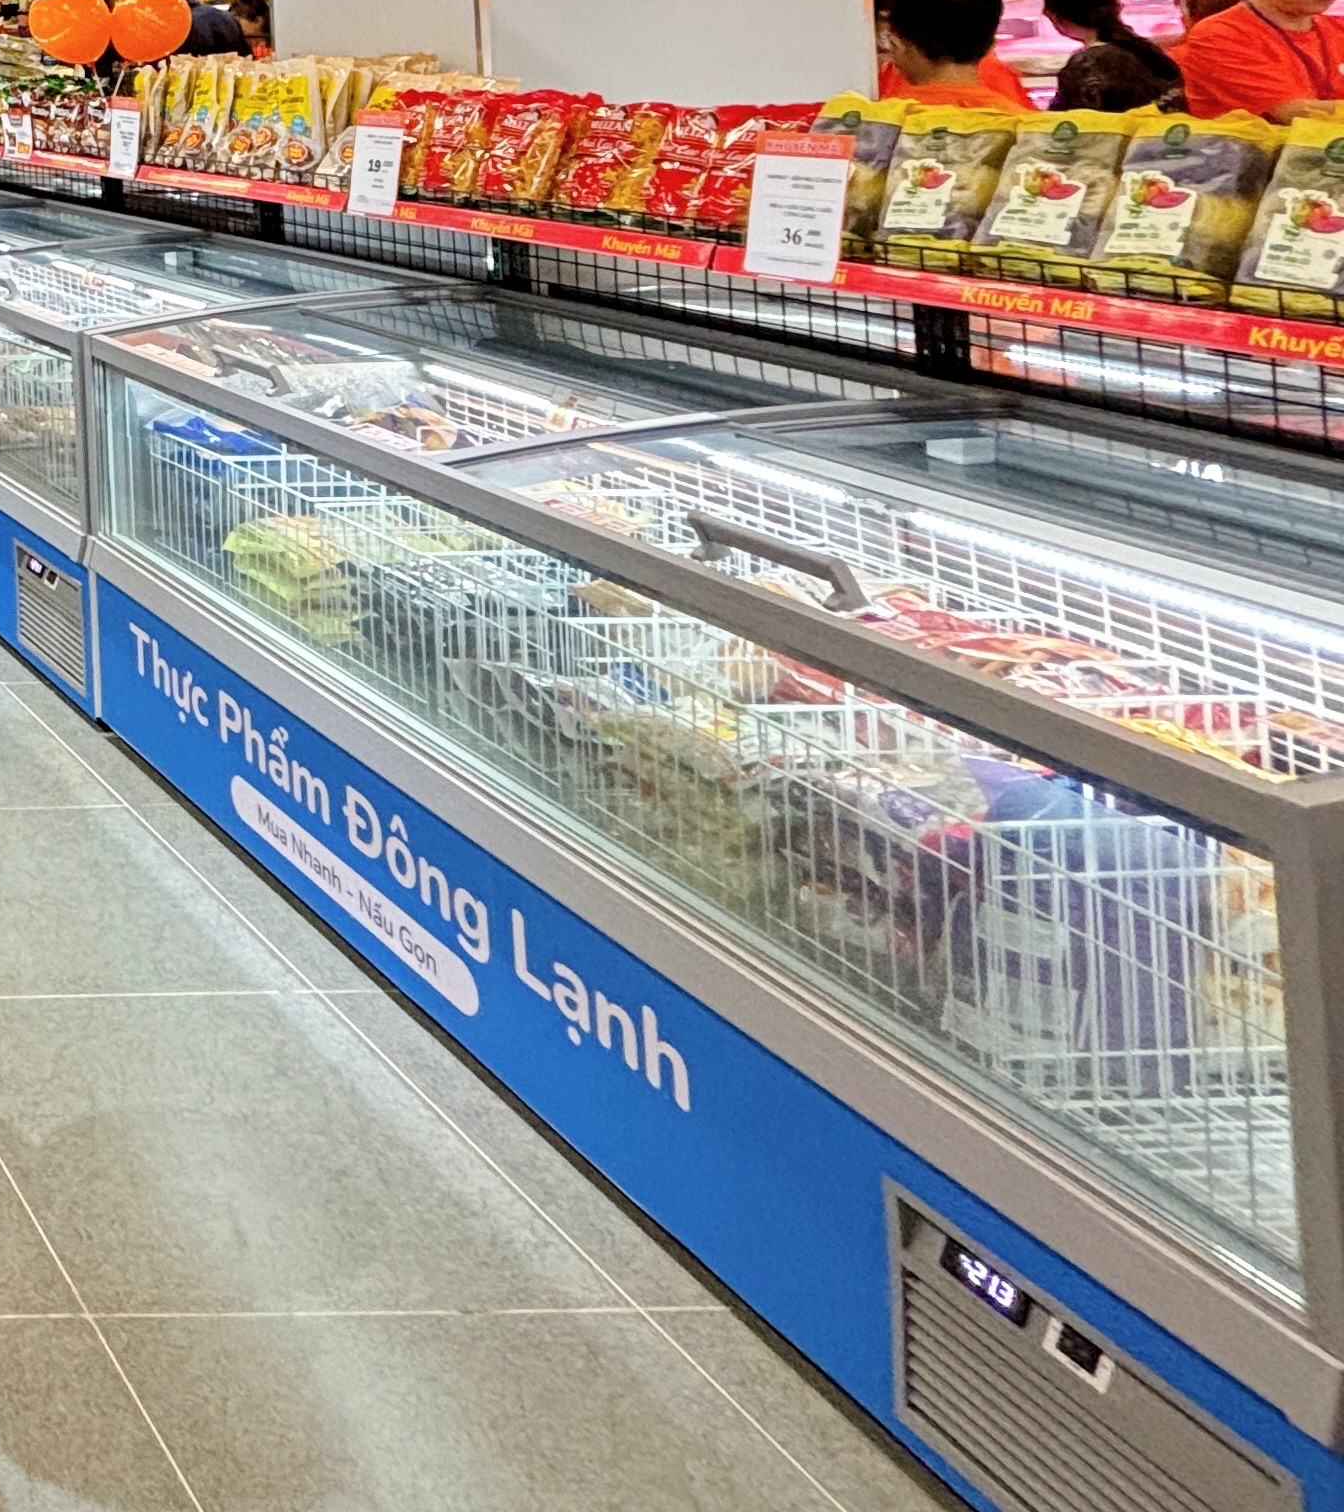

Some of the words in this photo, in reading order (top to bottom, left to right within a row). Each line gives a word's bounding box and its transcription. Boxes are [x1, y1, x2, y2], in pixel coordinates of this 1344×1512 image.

[367, 159, 382, 173] 19
[470, 217, 513, 234] Khuyến
[780, 227, 803, 245] 36
[600, 235, 653, 256] Khuyến
[655, 243, 682, 260] Mãi
[960, 286, 1043, 314] Khuyến
[1050, 296, 1097, 321] Mãi
[1248, 325, 1344, 358] Khuyế
[128, 621, 210, 727] Thực
[217, 687, 332, 826] Phẩm
[341, 784, 491, 965] Đông
[510, 907, 692, 1113] Lạnh
[257, 802, 289, 847] Mua
[290, 831, 343, 894] Nhanh
[357, 888, 395, 937] Nấu
[398, 923, 439, 976] Gọn
